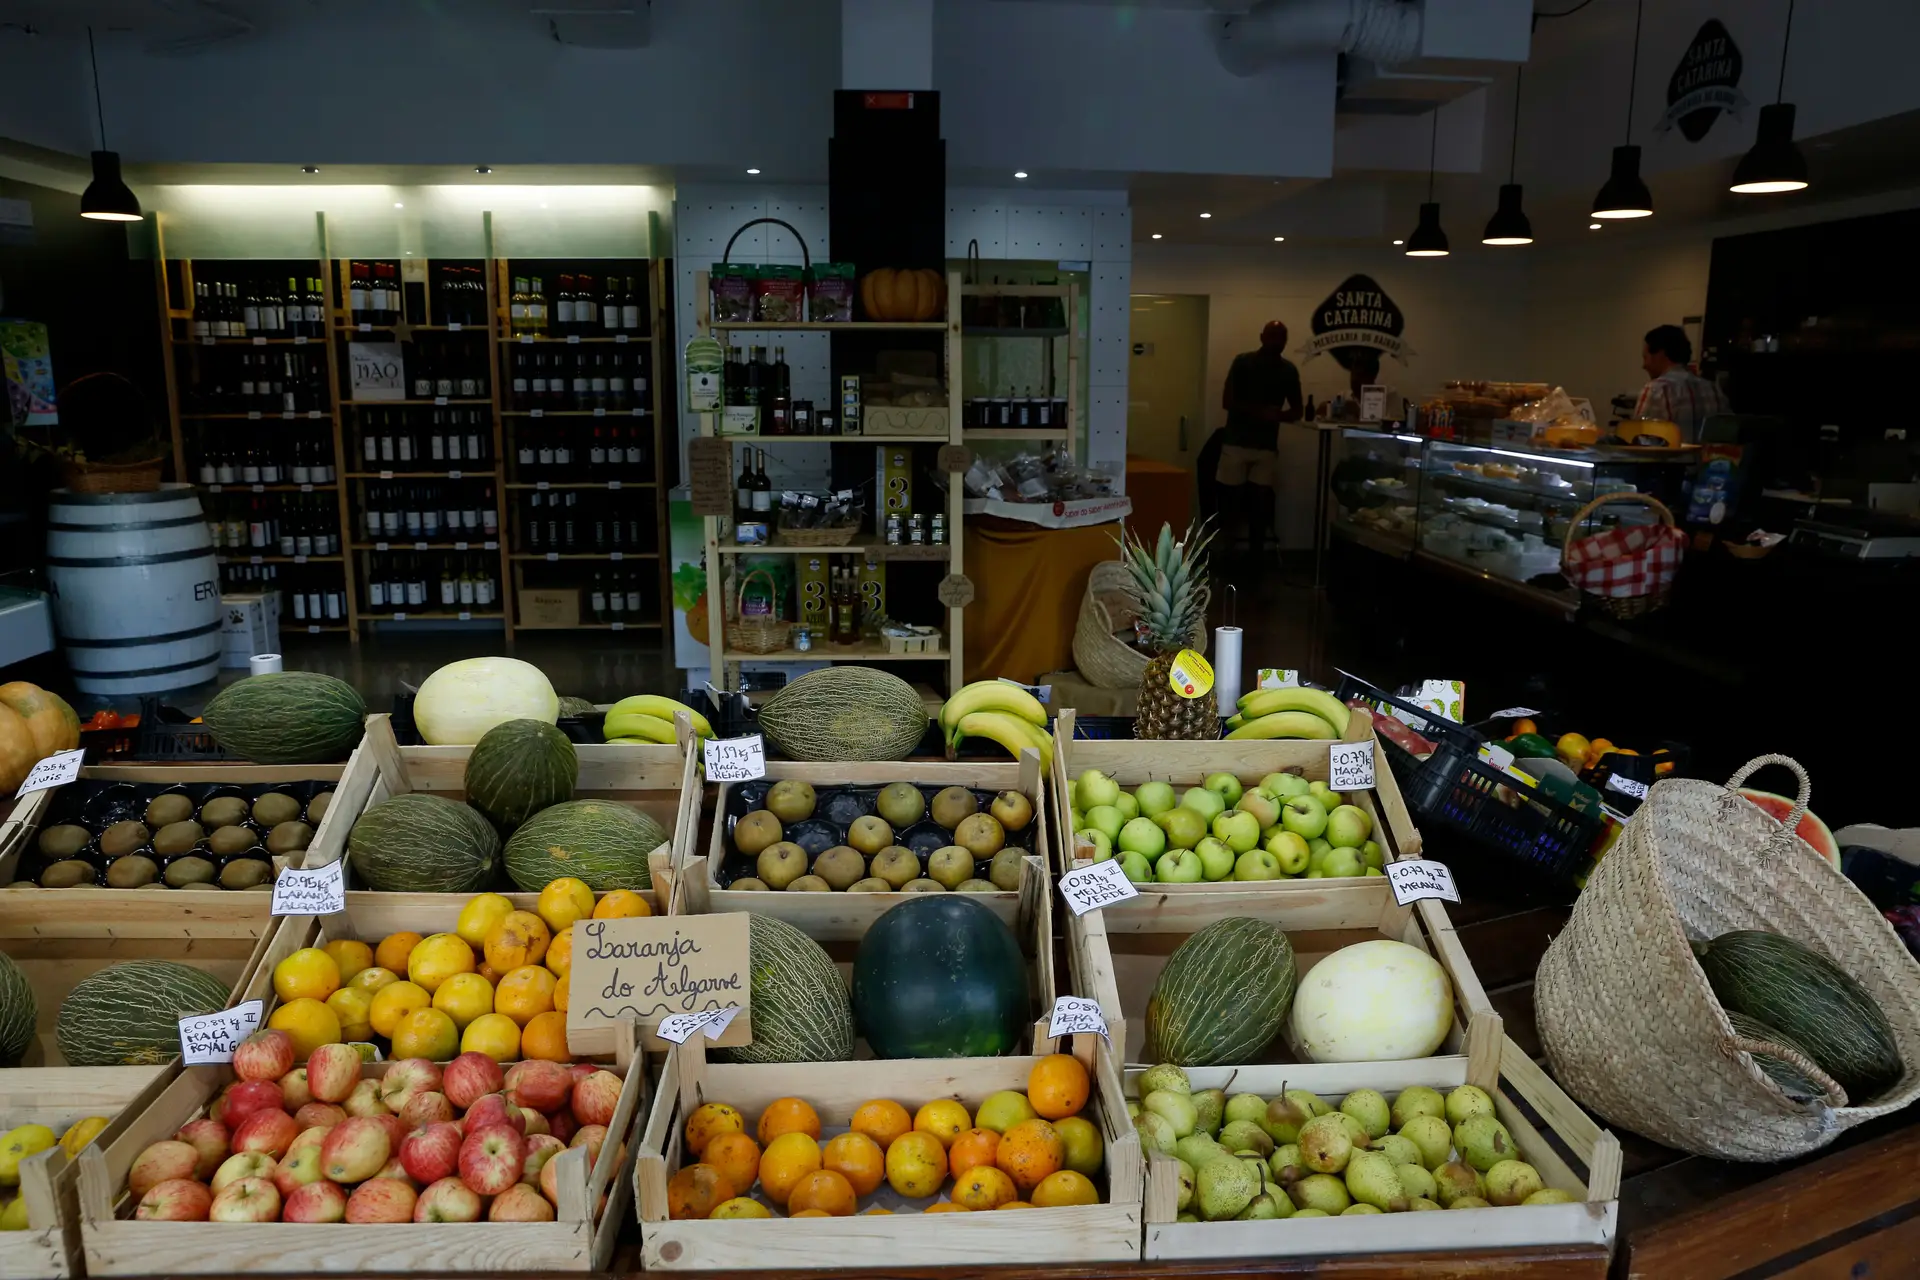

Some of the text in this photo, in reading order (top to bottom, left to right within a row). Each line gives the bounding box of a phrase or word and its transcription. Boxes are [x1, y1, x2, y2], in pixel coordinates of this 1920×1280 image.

[1688, 36, 1727, 63] SANTA
[1677, 57, 1733, 94] CATARINA
[1335, 290, 1383, 308] SANTA
[1323, 309, 1393, 329] CATARINA
[1313, 333, 1358, 348] MERCEARIA
[888, 477, 909, 509] 3
[805, 580, 826, 612] 3
[1334, 764, 1364, 777] MAÇÃ
[278, 890, 335, 904] LARANJA
[1073, 883, 1117, 900] MELÃO
[1080, 887, 1129, 907] VERDE
[279, 901, 340, 911] ALGARVE
[586, 921, 702, 967] Laranja
[602, 962, 742, 1010] do Algarve
[187, 1027, 229, 1043] MAÇÃ
[187, 1041, 227, 1055] ROYAL
